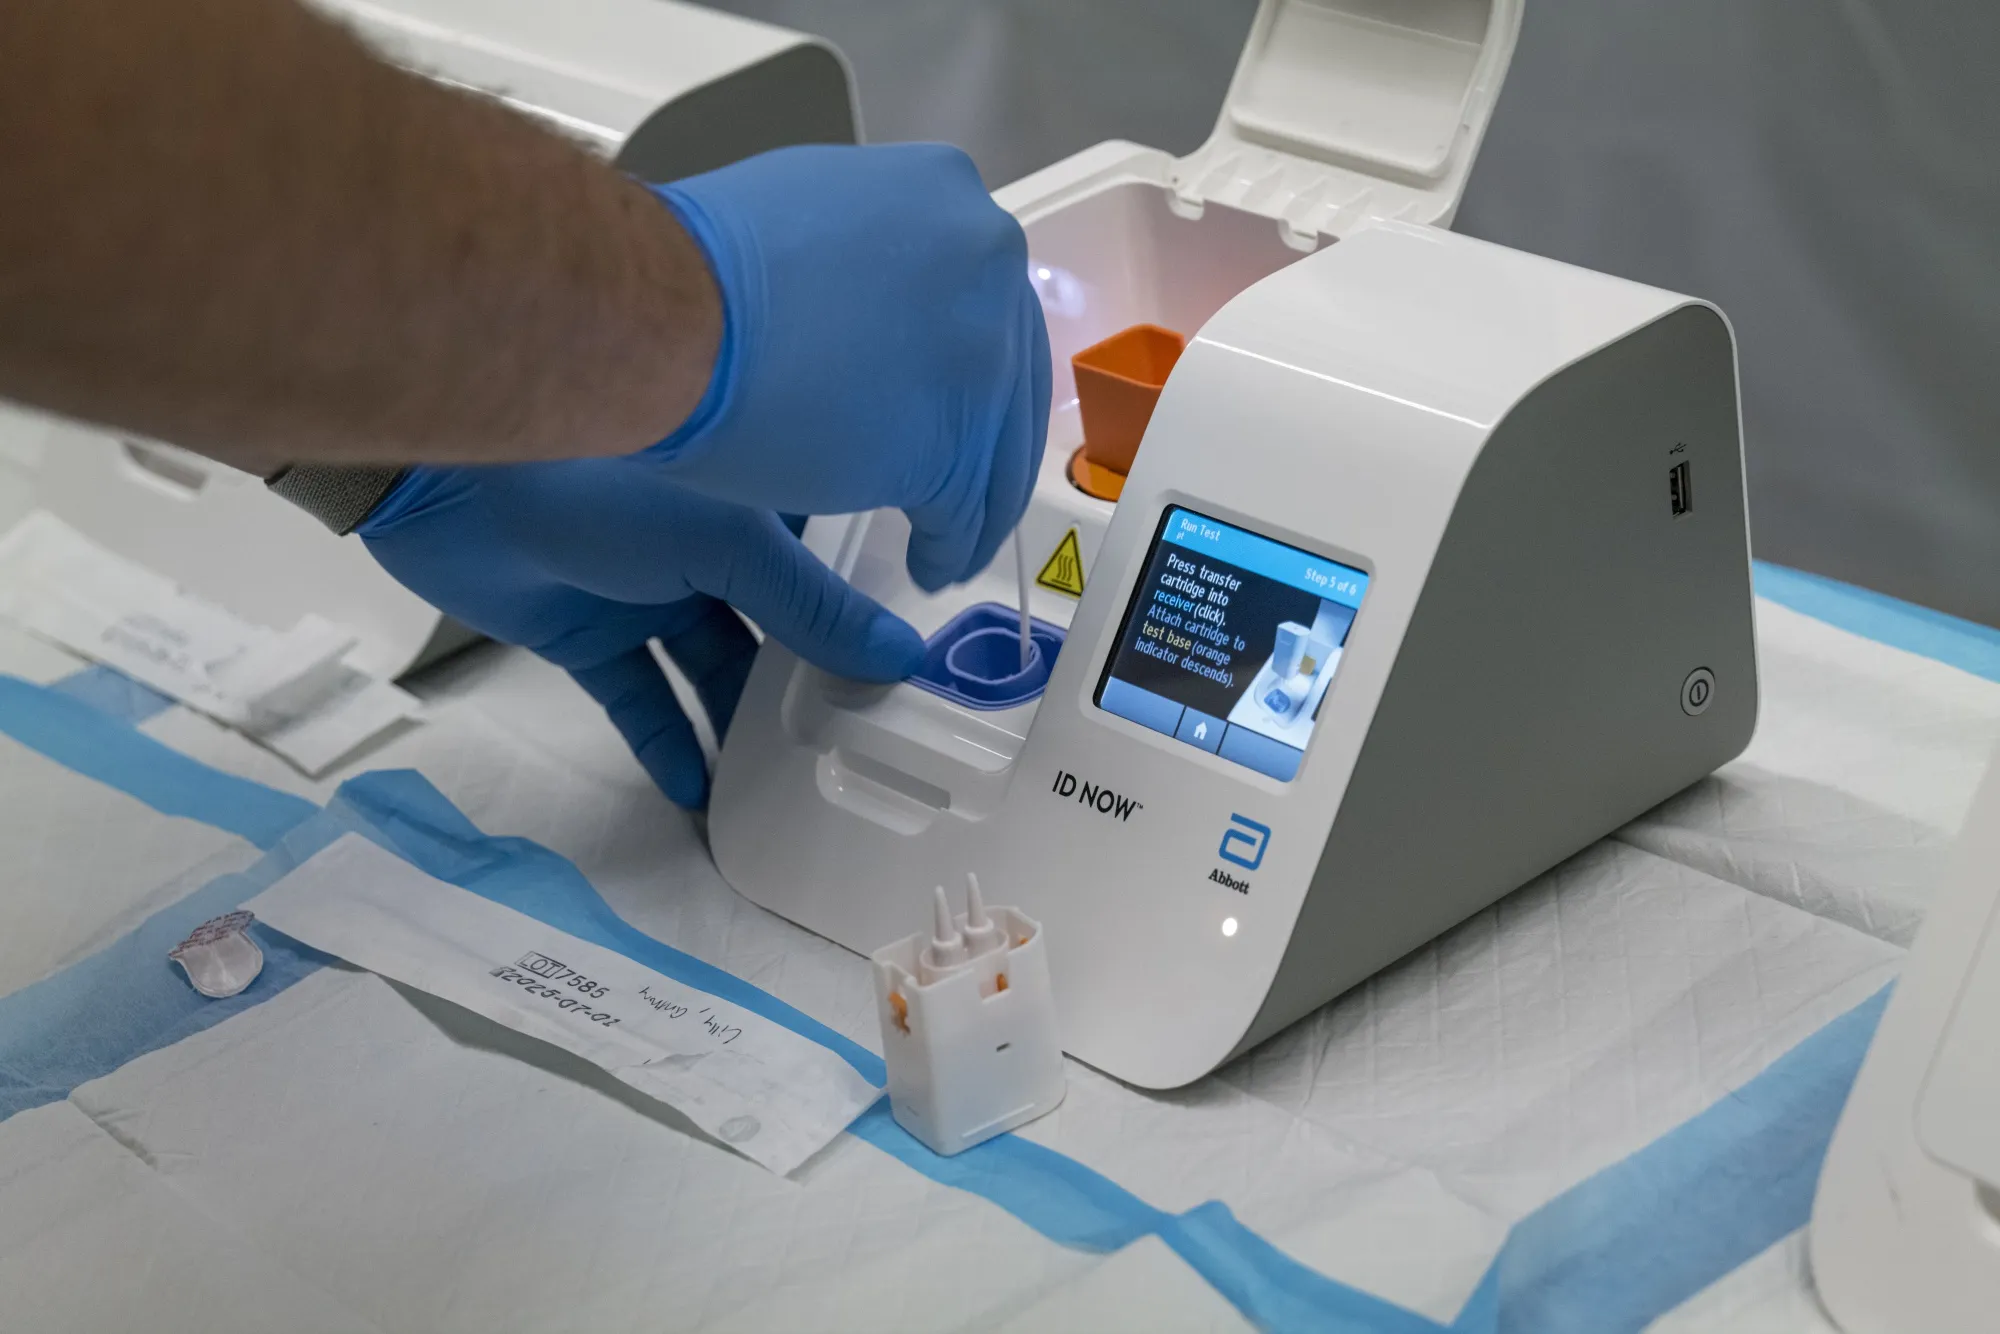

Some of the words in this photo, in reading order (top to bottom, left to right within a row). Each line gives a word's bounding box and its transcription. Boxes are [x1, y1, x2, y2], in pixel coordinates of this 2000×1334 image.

[1180, 518, 1198, 533] Run
[1200, 522, 1221, 542] Test
[1160, 572, 1205, 600] cartridge
[1207, 586, 1229, 606] into
[1166, 553, 1196, 575] Press
[1199, 564, 1242, 592] transfer
[1304, 567, 1328, 588] Step
[1328, 575, 1336, 588] 5
[1337, 578, 1351, 593] of
[1349, 583, 1357, 596] 6
[1153, 589, 1195, 613] receiver
[1193, 602, 1226, 627] (click).
[1142, 620, 1164, 641] test
[1166, 627, 1192, 651] base
[1191, 639, 1232, 667] (orange
[1147, 604, 1182, 627] Attach
[1184, 620, 1230, 646] cartridge
[1233, 637, 1246, 652] to
[1134, 636, 1179, 665] indicator
[1180, 651, 1235, 689] descends).
[1052, 770, 1077, 797] ID
[1208, 868, 1250, 895] Abbott
[517, 953, 564, 978] LOT
[555, 968, 610, 999] 7585
[499, 966, 621, 1028] 2025-07-01
